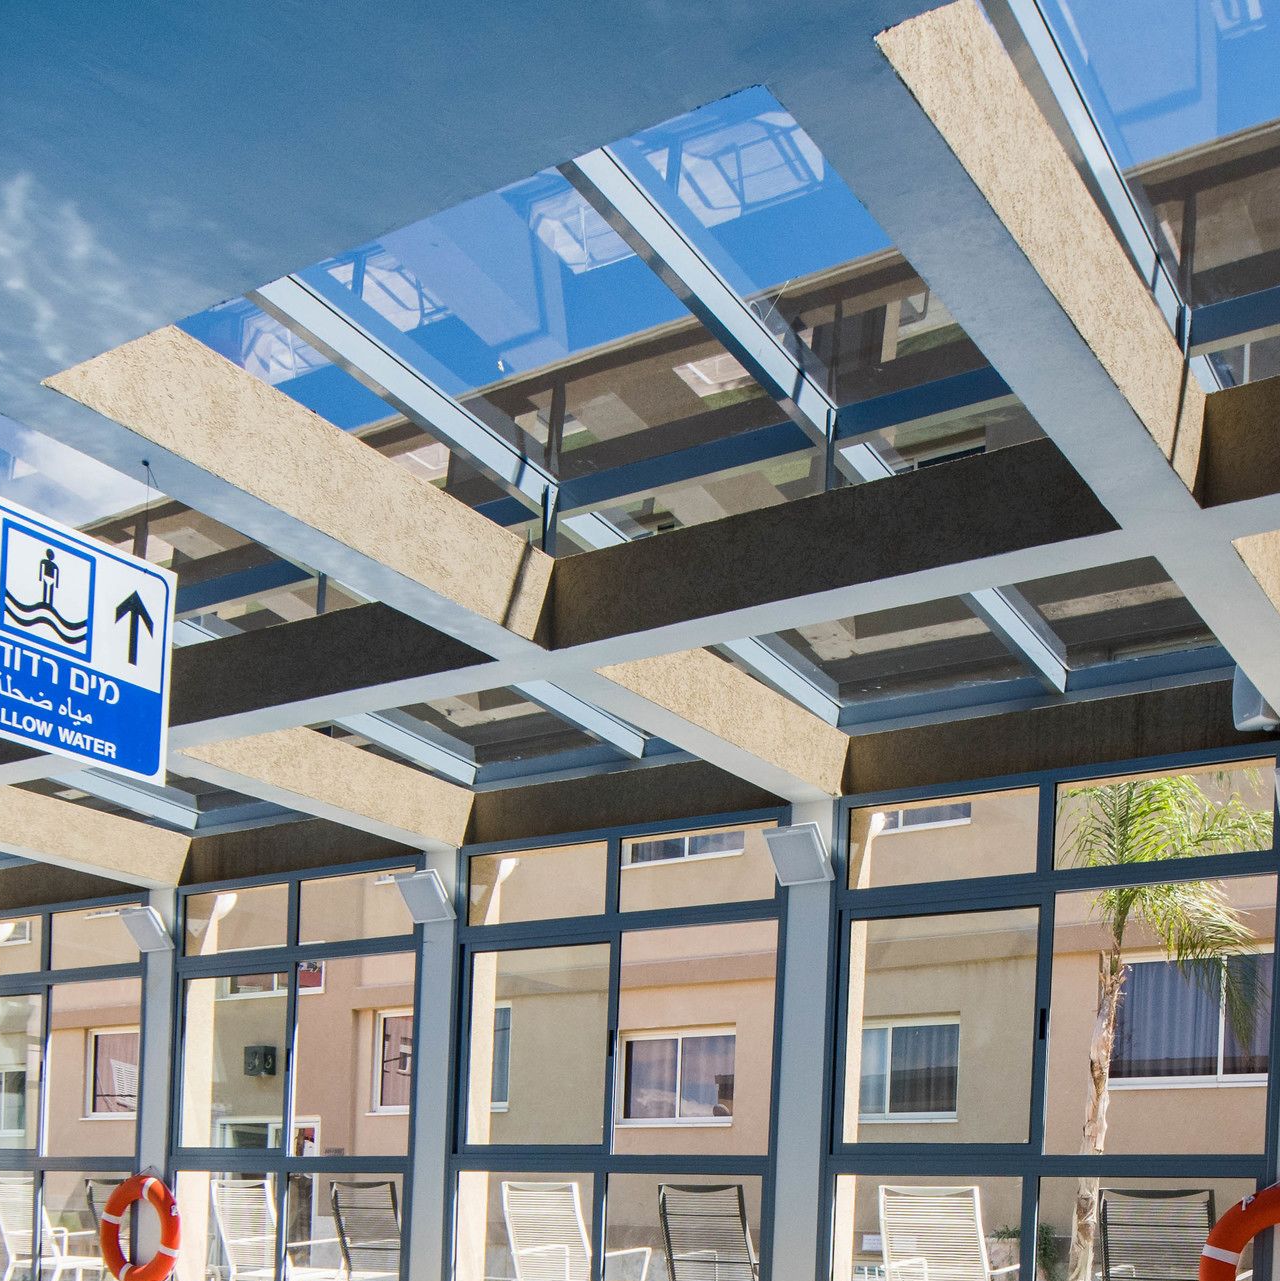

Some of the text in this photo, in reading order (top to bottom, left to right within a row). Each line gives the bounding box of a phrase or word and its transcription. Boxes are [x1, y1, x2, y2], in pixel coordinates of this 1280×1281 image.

[69, 667, 120, 705] מים
[58, 697, 93, 726] مياه
[57, 726, 117, 759] WATER
